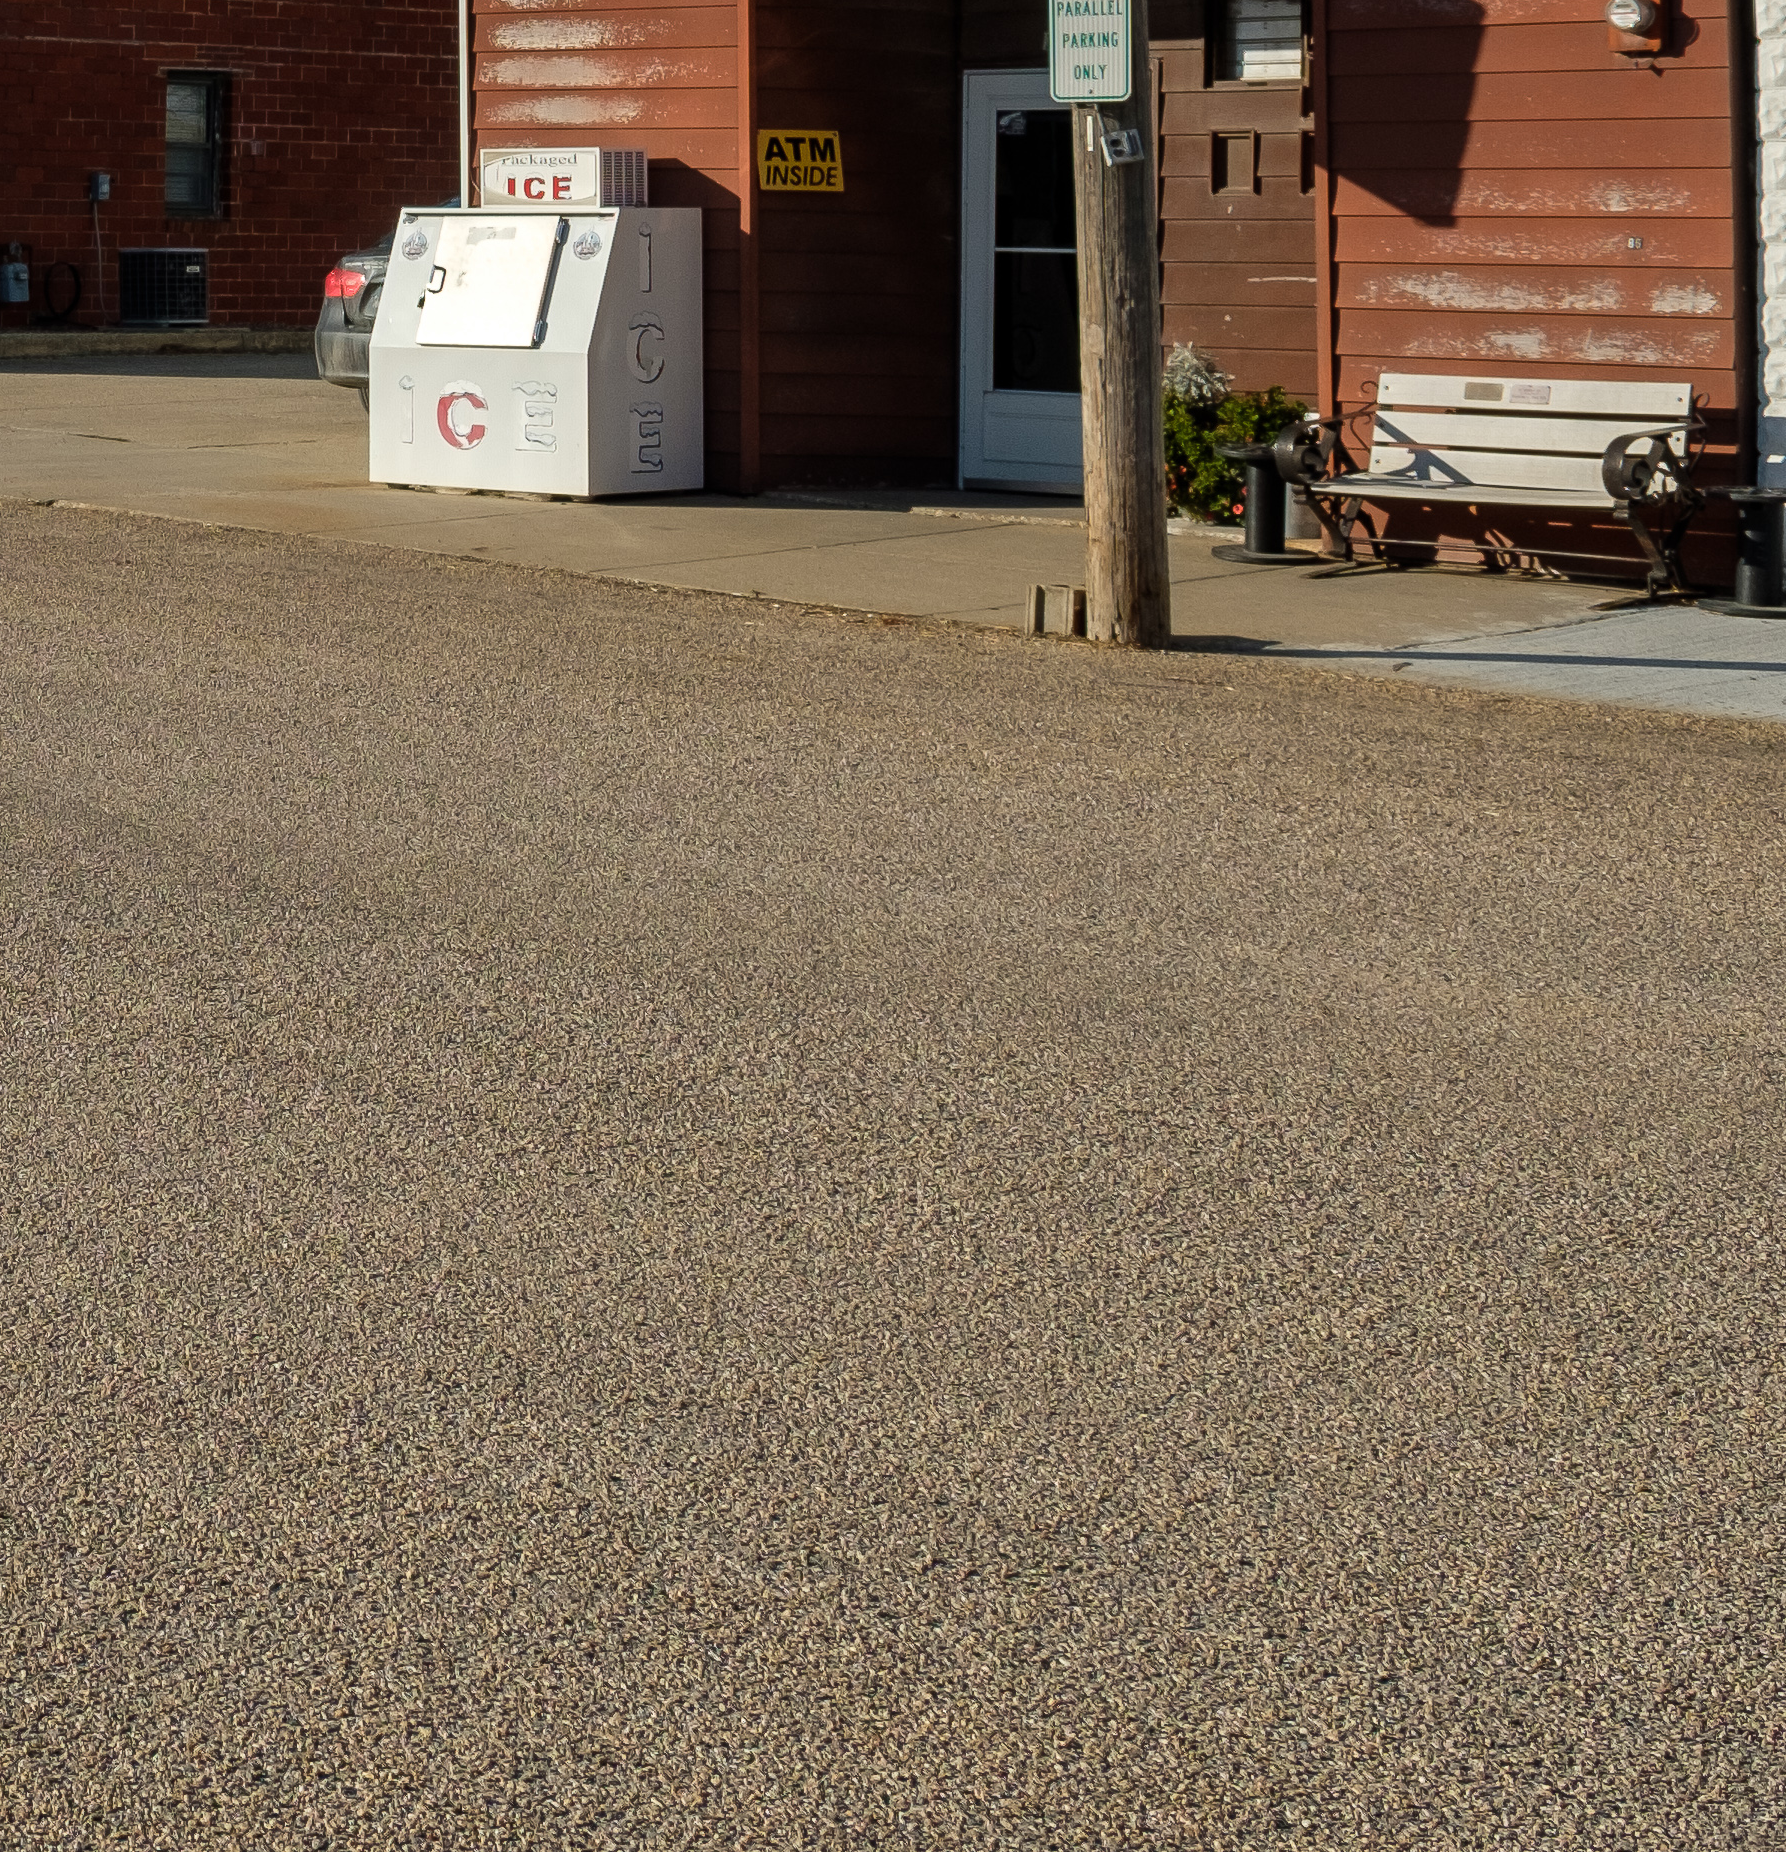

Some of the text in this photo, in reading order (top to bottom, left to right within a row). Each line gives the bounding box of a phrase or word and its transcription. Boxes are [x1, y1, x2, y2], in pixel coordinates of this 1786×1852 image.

[1057, 0, 1123, 17] PARALLEL
[1062, 32, 1119, 48] PARKING
[1074, 64, 1107, 80] ONLY
[765, 137, 837, 163] ATM
[766, 165, 838, 186] INSIDE
[507, 174, 572, 200] ICE
